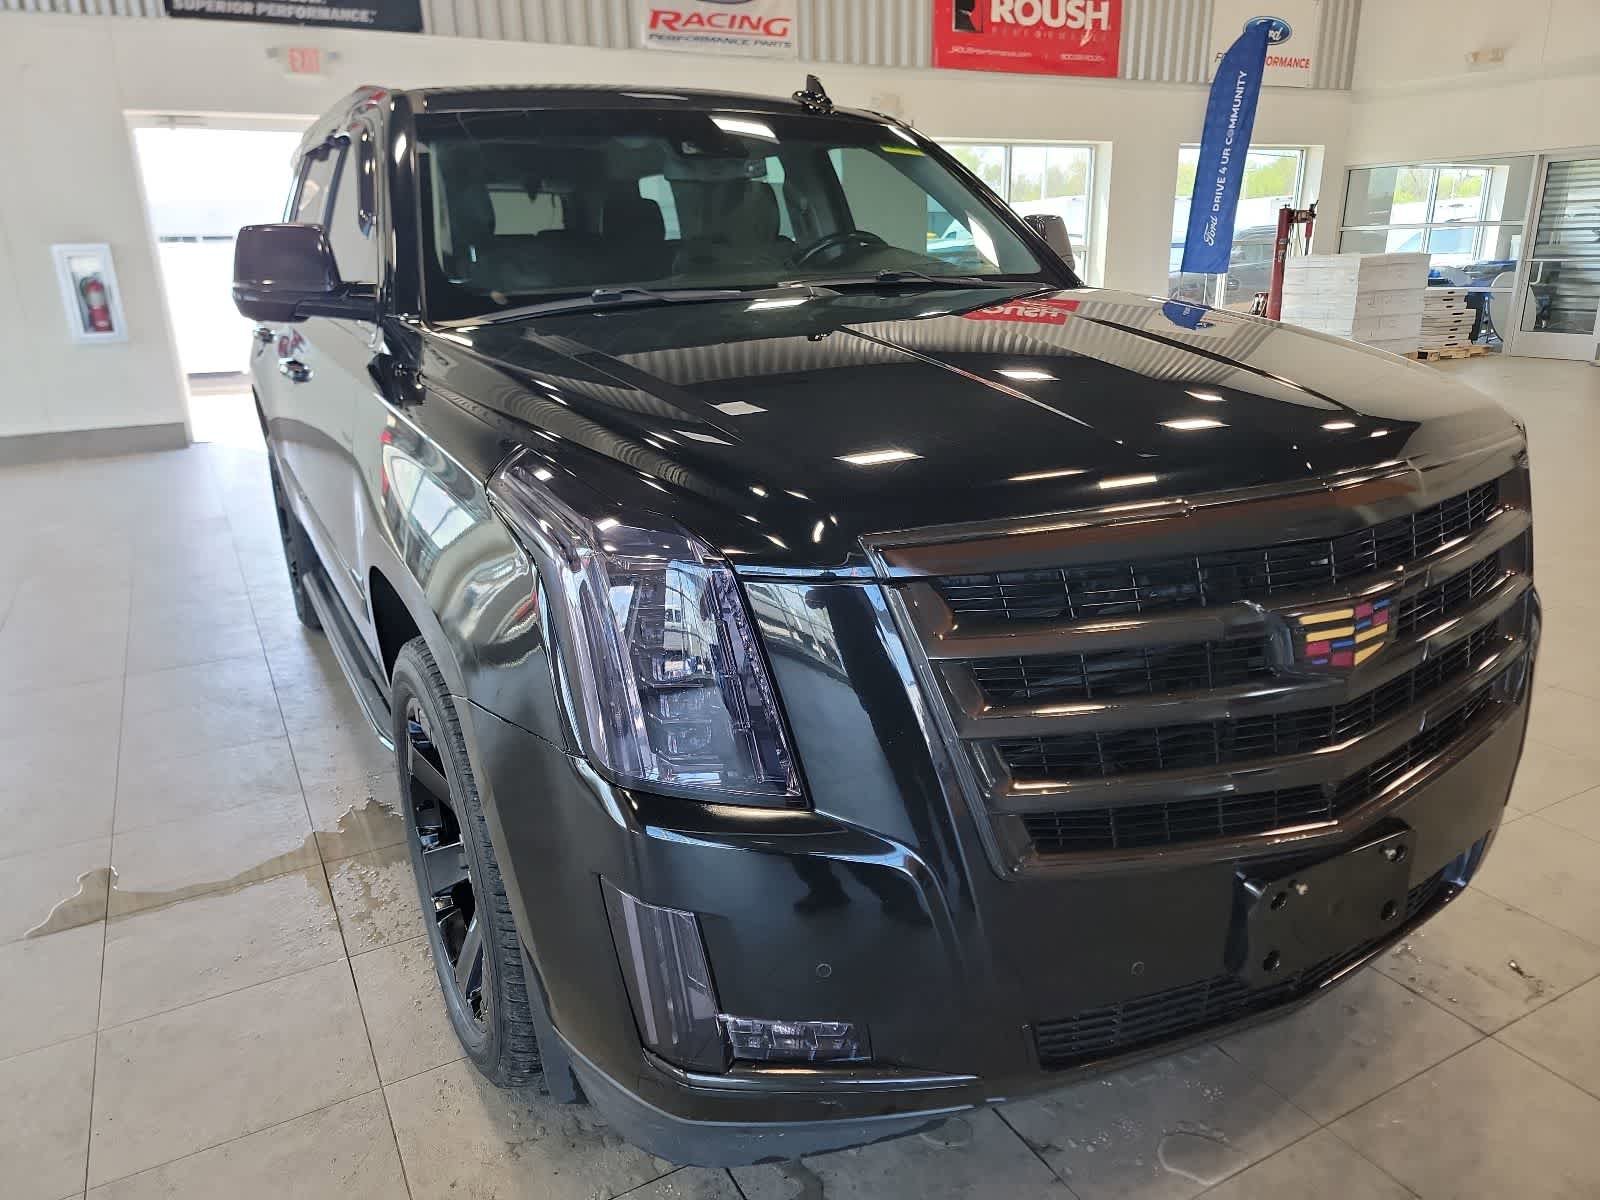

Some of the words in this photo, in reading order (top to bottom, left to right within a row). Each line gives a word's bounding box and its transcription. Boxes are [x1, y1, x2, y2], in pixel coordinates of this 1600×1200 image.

[173, 1, 254, 16] SUPERIOR
[990, 0, 1111, 34] ROUSH
[649, 8, 792, 37] RACING
[648, 33, 750, 46] PERFORMANCE
[753, 39, 793, 49] PARTS
[1264, 55, 1311, 69] ORMANCE
[1225, 70, 1249, 145] COMMUNITY
[1221, 147, 1232, 165] UR
[1217, 166, 1228, 175] 4
[1212, 177, 1227, 212] DRIVE
[1203, 216, 1219, 246] Ford
